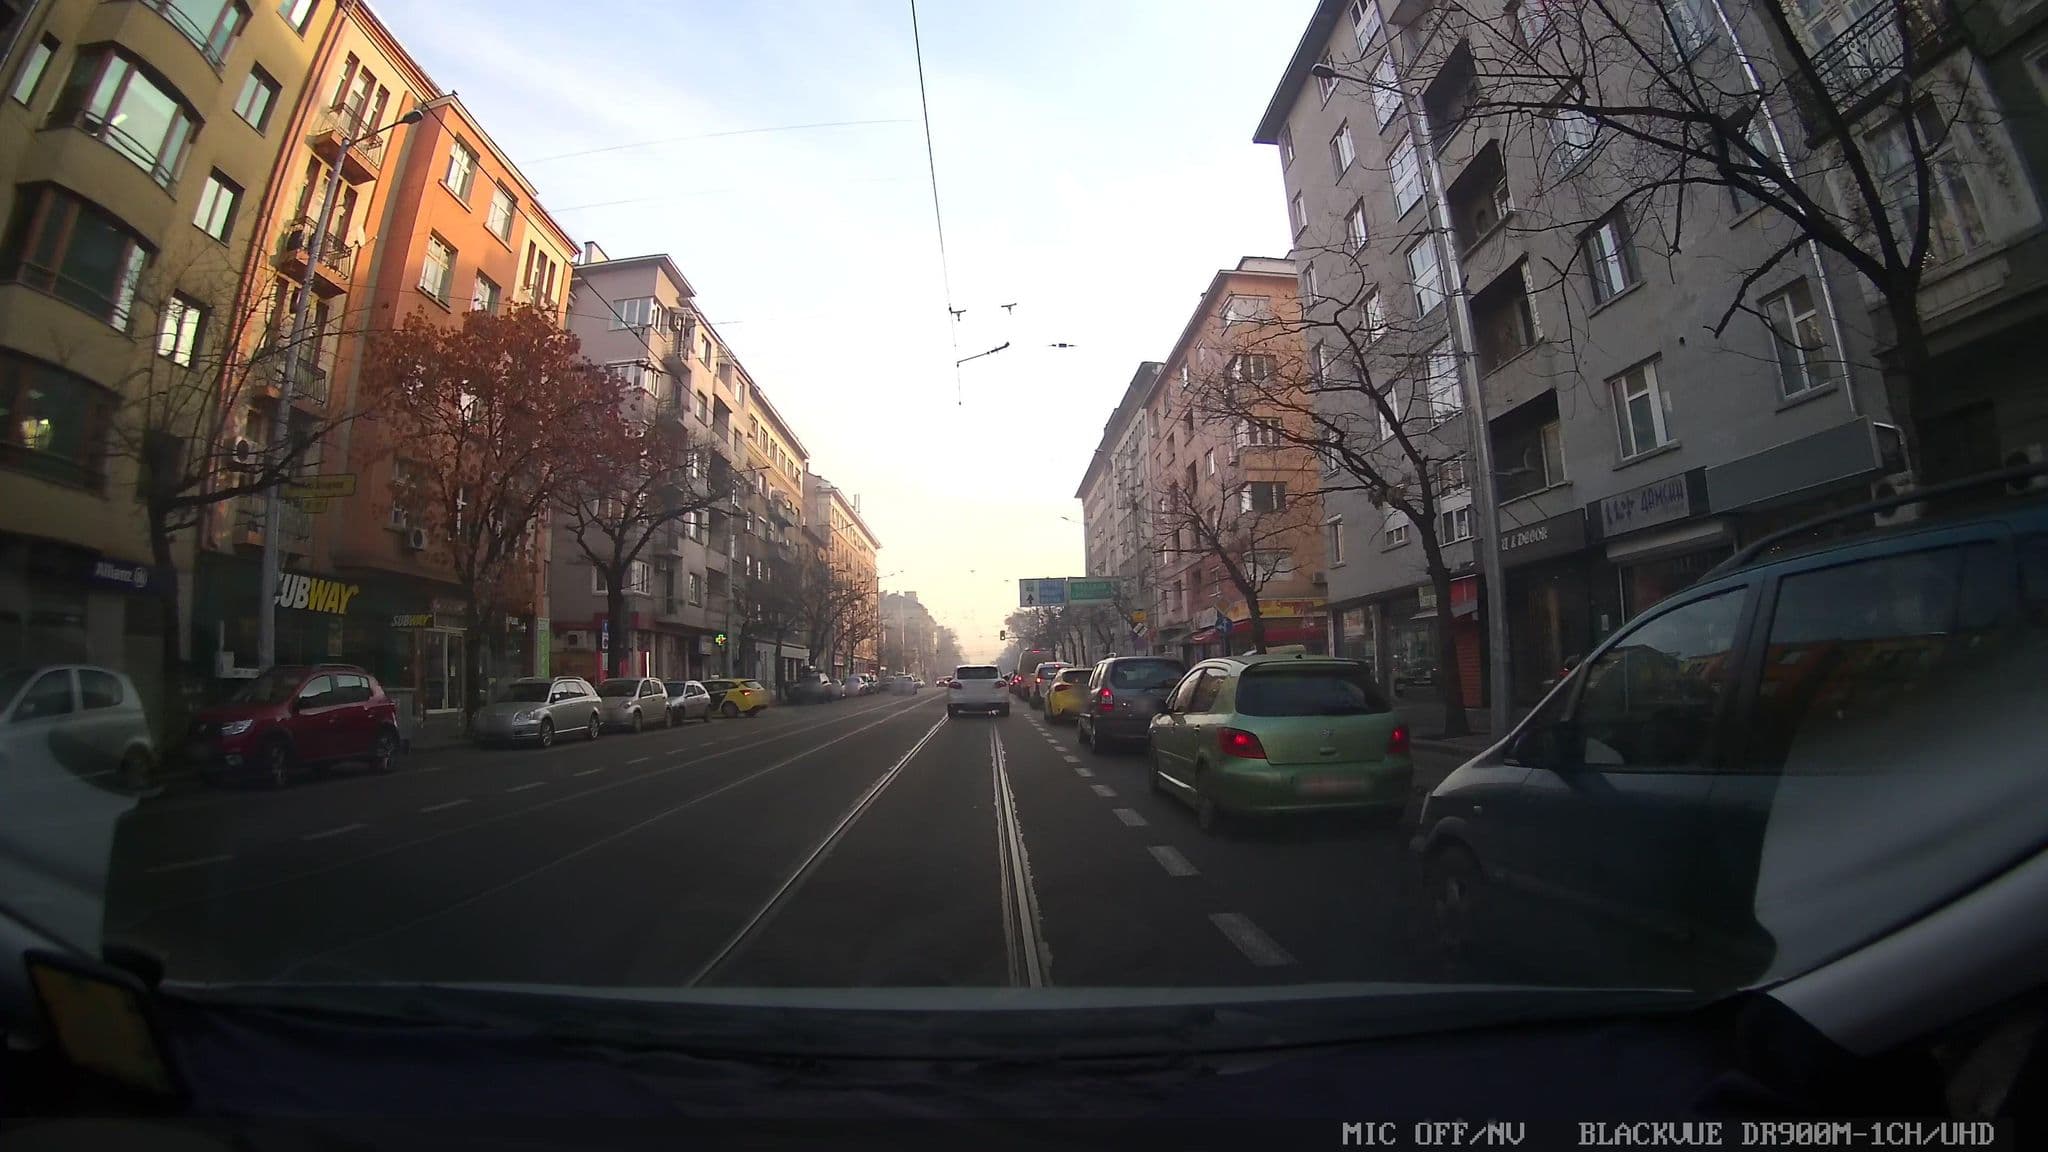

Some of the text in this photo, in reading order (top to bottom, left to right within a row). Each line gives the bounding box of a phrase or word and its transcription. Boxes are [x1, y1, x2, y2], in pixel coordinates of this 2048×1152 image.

[1517, 526, 1548, 546] DECOR
[95, 561, 133, 582] Allianz
[391, 614, 433, 627] SUBWAY
